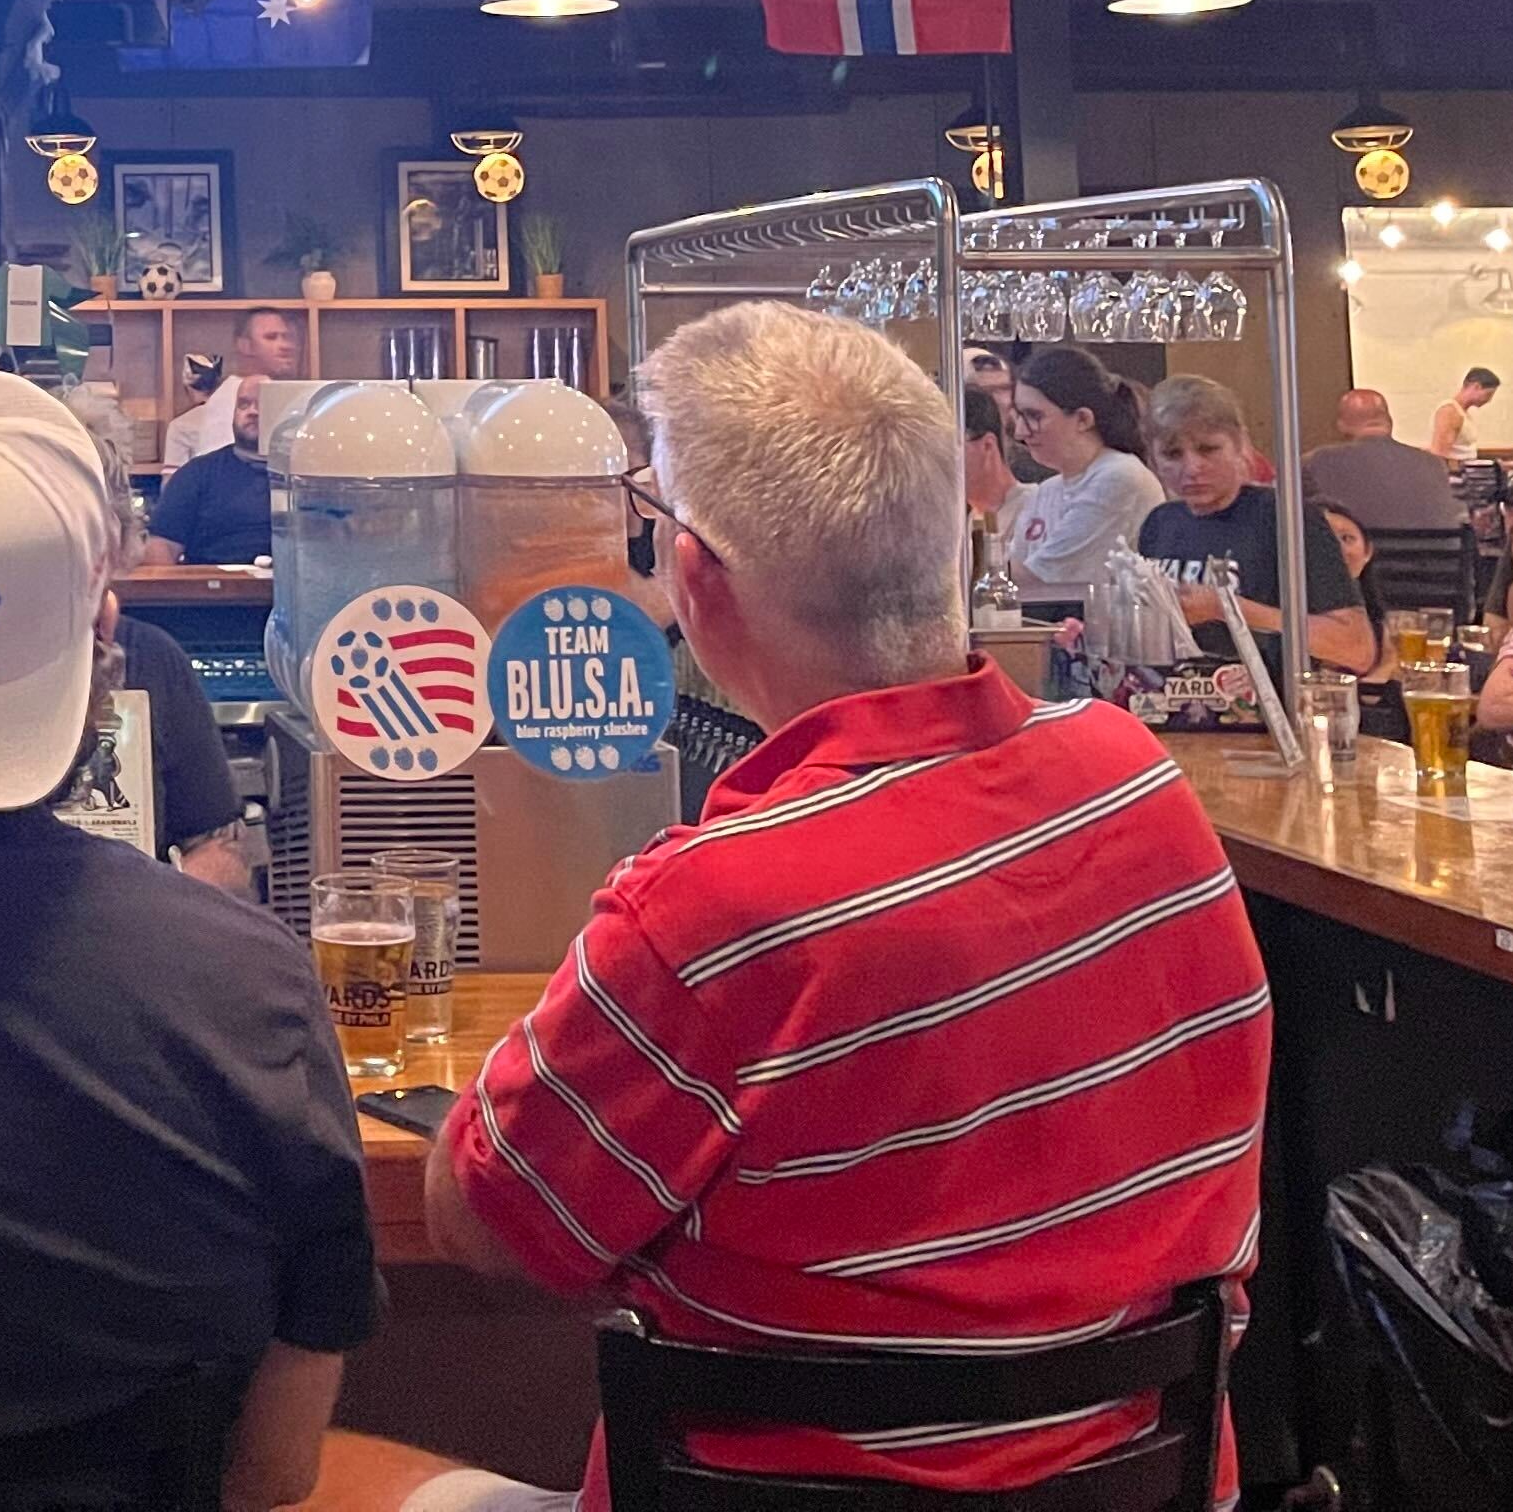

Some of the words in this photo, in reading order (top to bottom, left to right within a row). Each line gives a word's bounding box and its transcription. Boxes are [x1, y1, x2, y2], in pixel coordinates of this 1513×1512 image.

[544, 625, 609, 655] TEAM
[506, 657, 654, 720] BLU.S.A.
[1170, 681, 1221, 696] YARD
[516, 724, 541, 738] blue
[544, 723, 601, 740] raspberry
